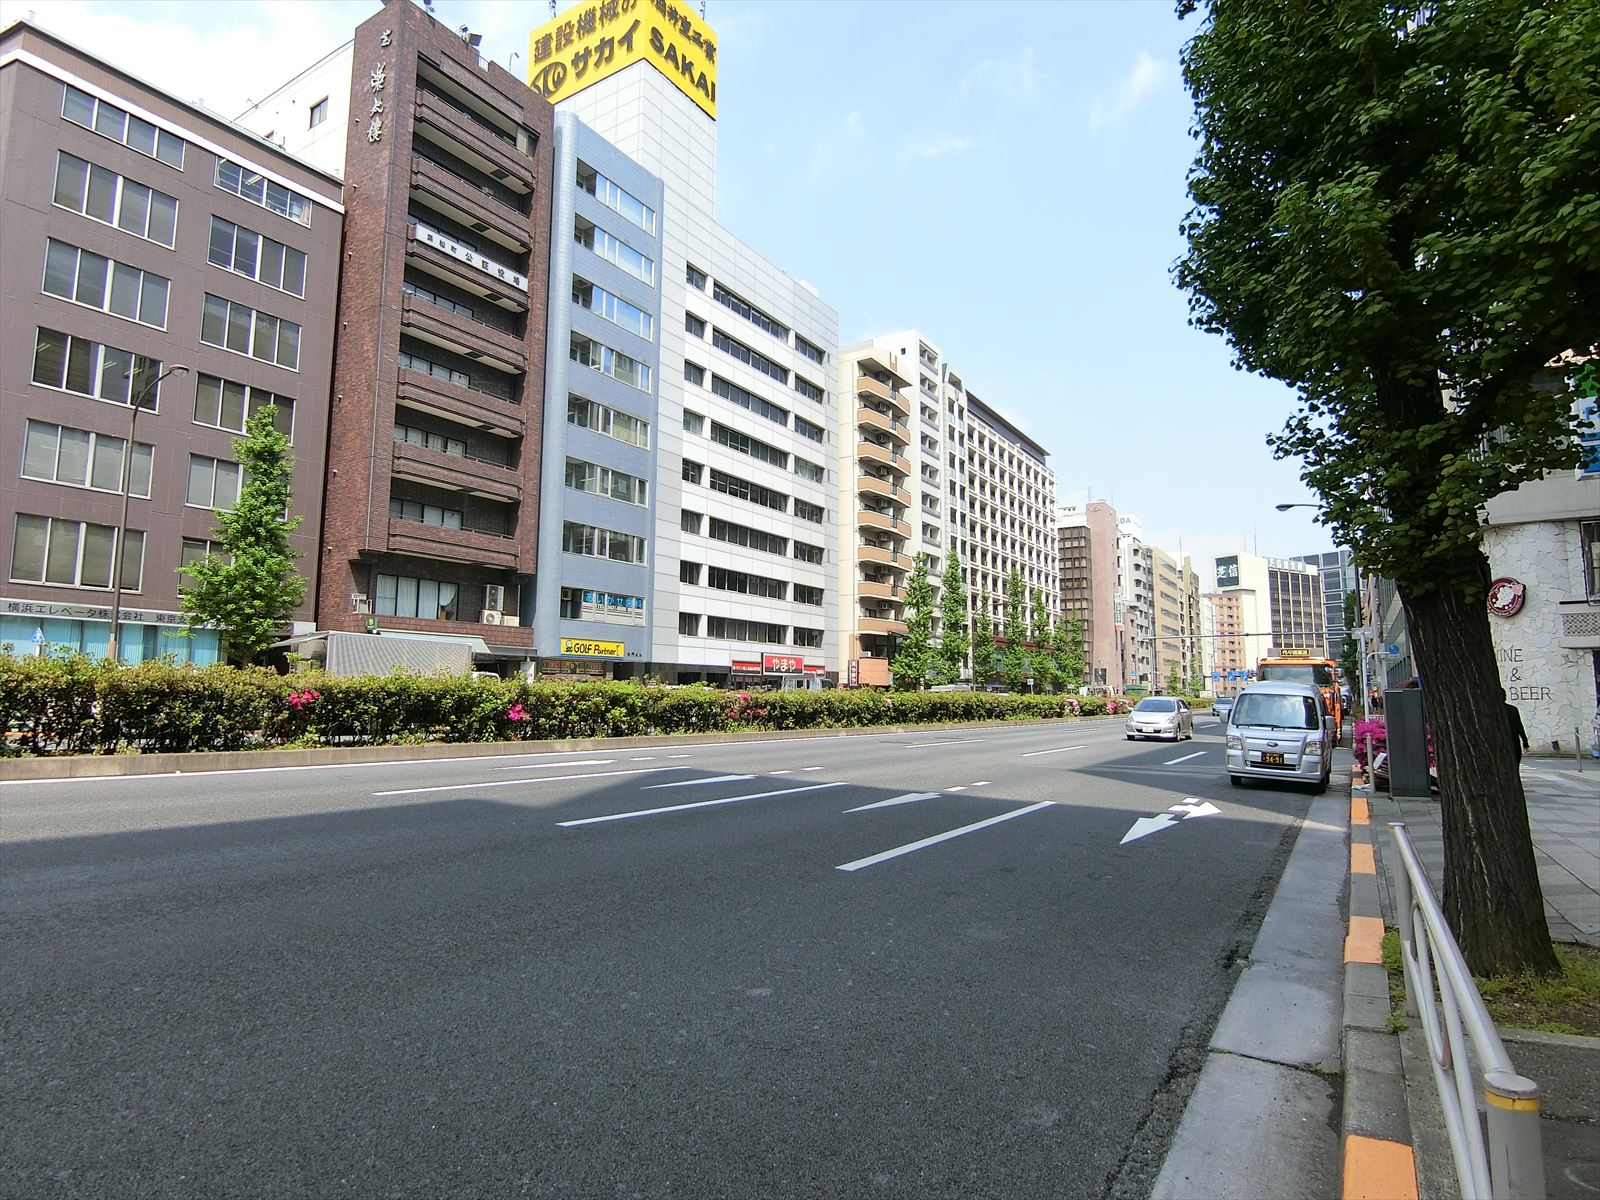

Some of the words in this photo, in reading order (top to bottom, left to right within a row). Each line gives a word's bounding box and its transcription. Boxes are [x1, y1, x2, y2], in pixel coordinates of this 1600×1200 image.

[571, 19, 641, 79] サカイ
[649, 26, 716, 102] SAKAI
[1216, 564, 1238, 579] 芝信
[573, 643, 592, 654] GOLF
[594, 644, 616, 656] Partner
[1497, 648, 1524, 662] INE
[772, 657, 797, 672] やまや
[1510, 667, 1521, 682] &
[1509, 686, 1552, 701] BEER
